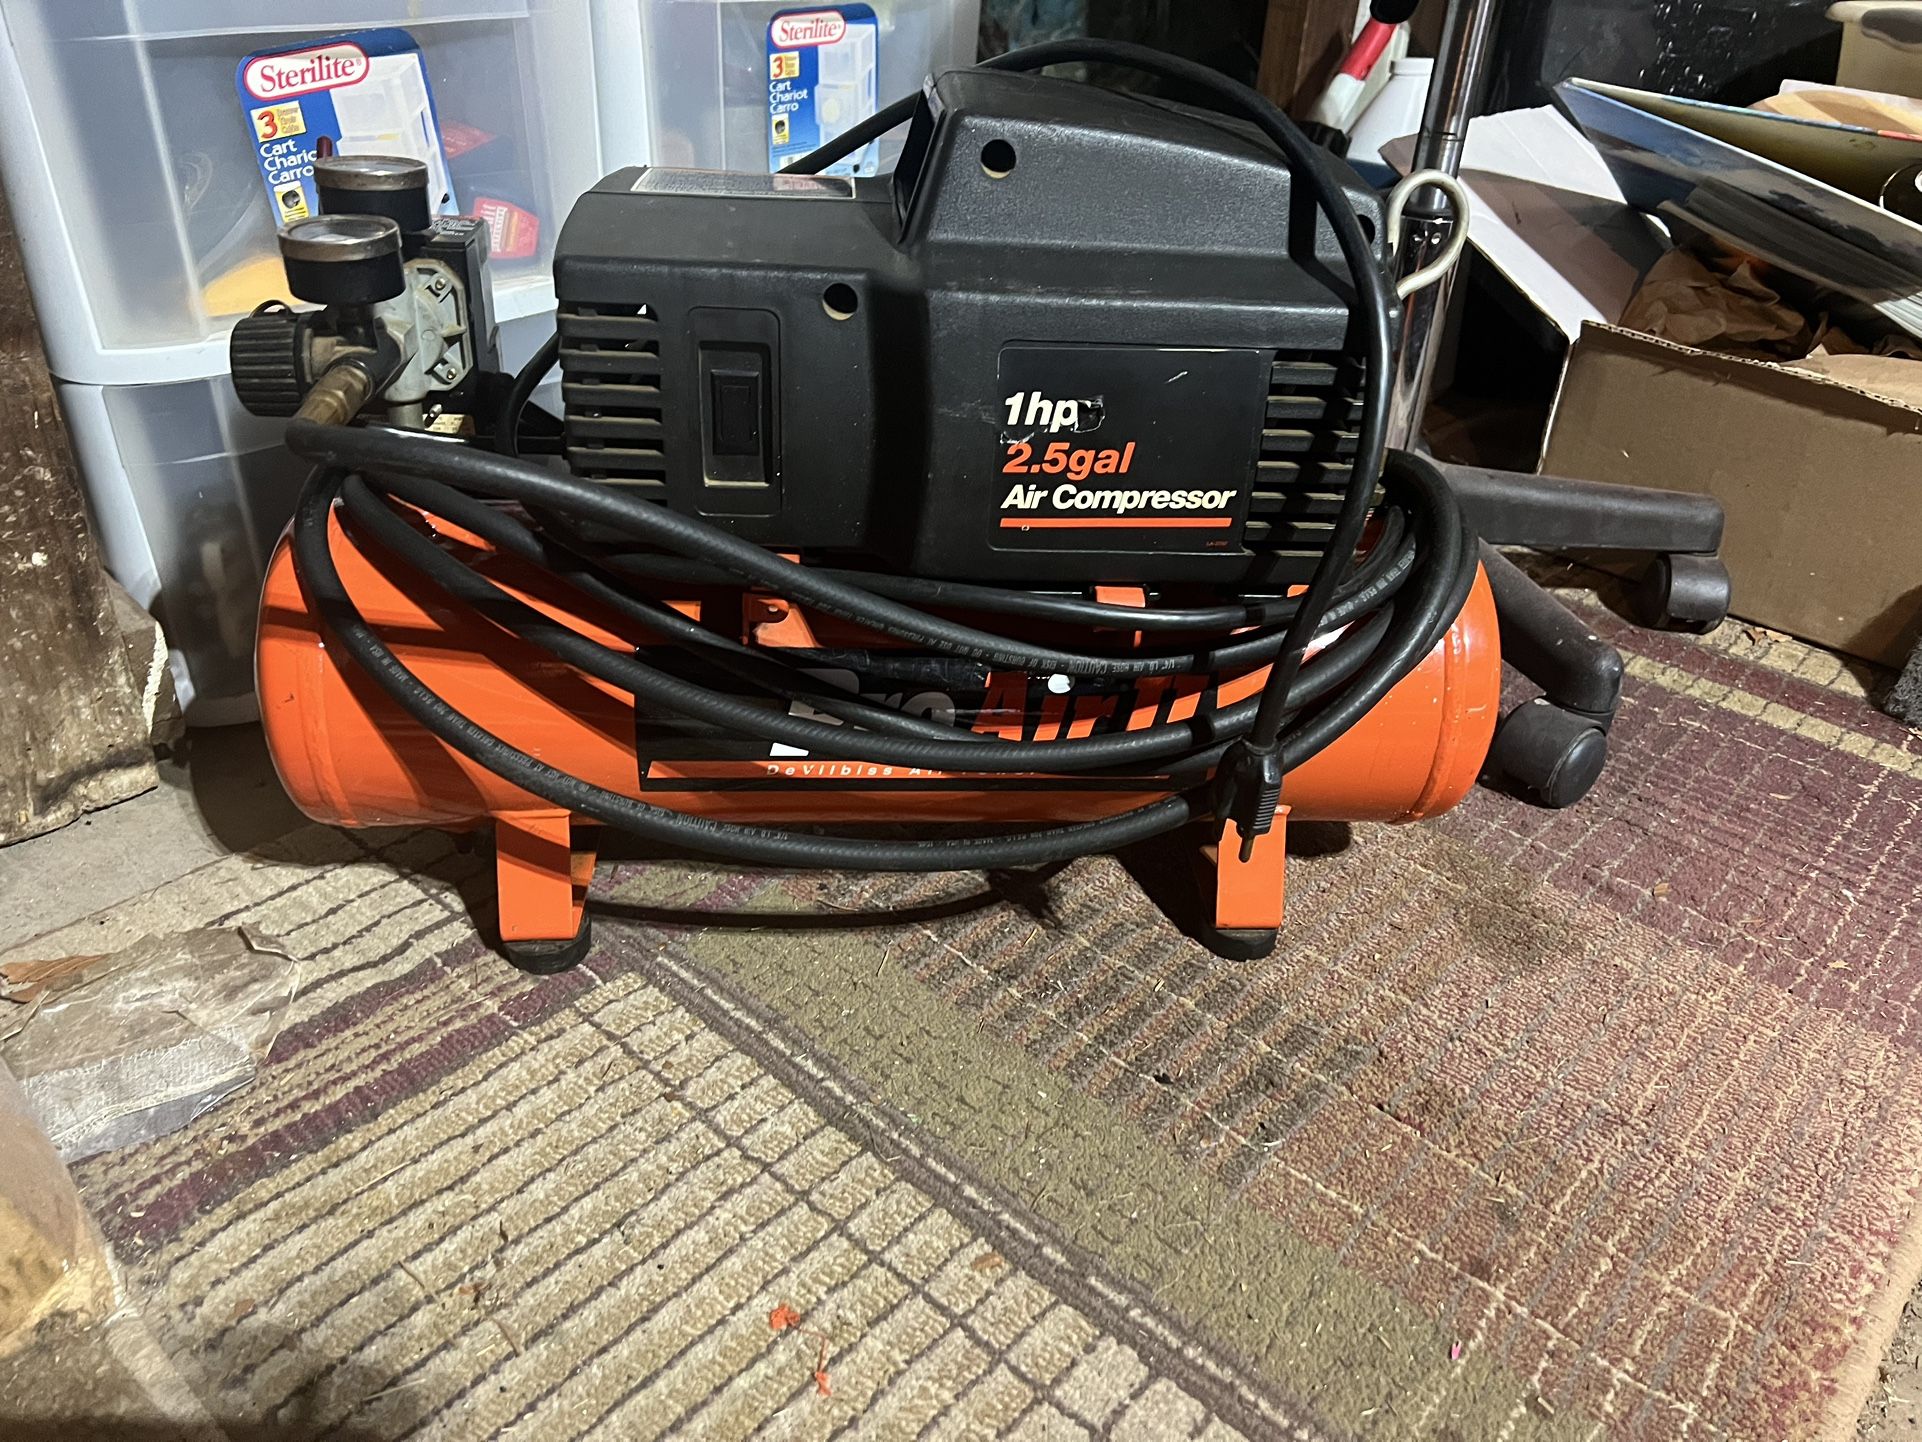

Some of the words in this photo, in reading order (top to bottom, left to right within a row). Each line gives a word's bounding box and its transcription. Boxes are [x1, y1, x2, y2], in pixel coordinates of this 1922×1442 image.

[780, 18, 837, 42] Sterilite
[260, 54, 356, 93] Sterilite
[772, 55, 784, 78] 3
[769, 80, 791, 92] Cart
[769, 89, 809, 103] Chariot
[769, 103, 799, 114] Carro
[257, 111, 278, 139] 3
[260, 139, 298, 158] Cart
[268, 165, 315, 184] Carro
[1004, 391, 1079, 433] 1hp
[1002, 441, 1136, 481] 2.5gal
[1000, 484, 1049, 510] Air
[1052, 484, 1238, 514] Compressor
[1029, 658, 1038, 668] OF
[1041, 659, 1058, 670] RISK
[1068, 658, 1108, 675] CAUTION
[1112, 662, 1130, 673] HOSE
[766, 764, 893, 776] DeVilbiss
